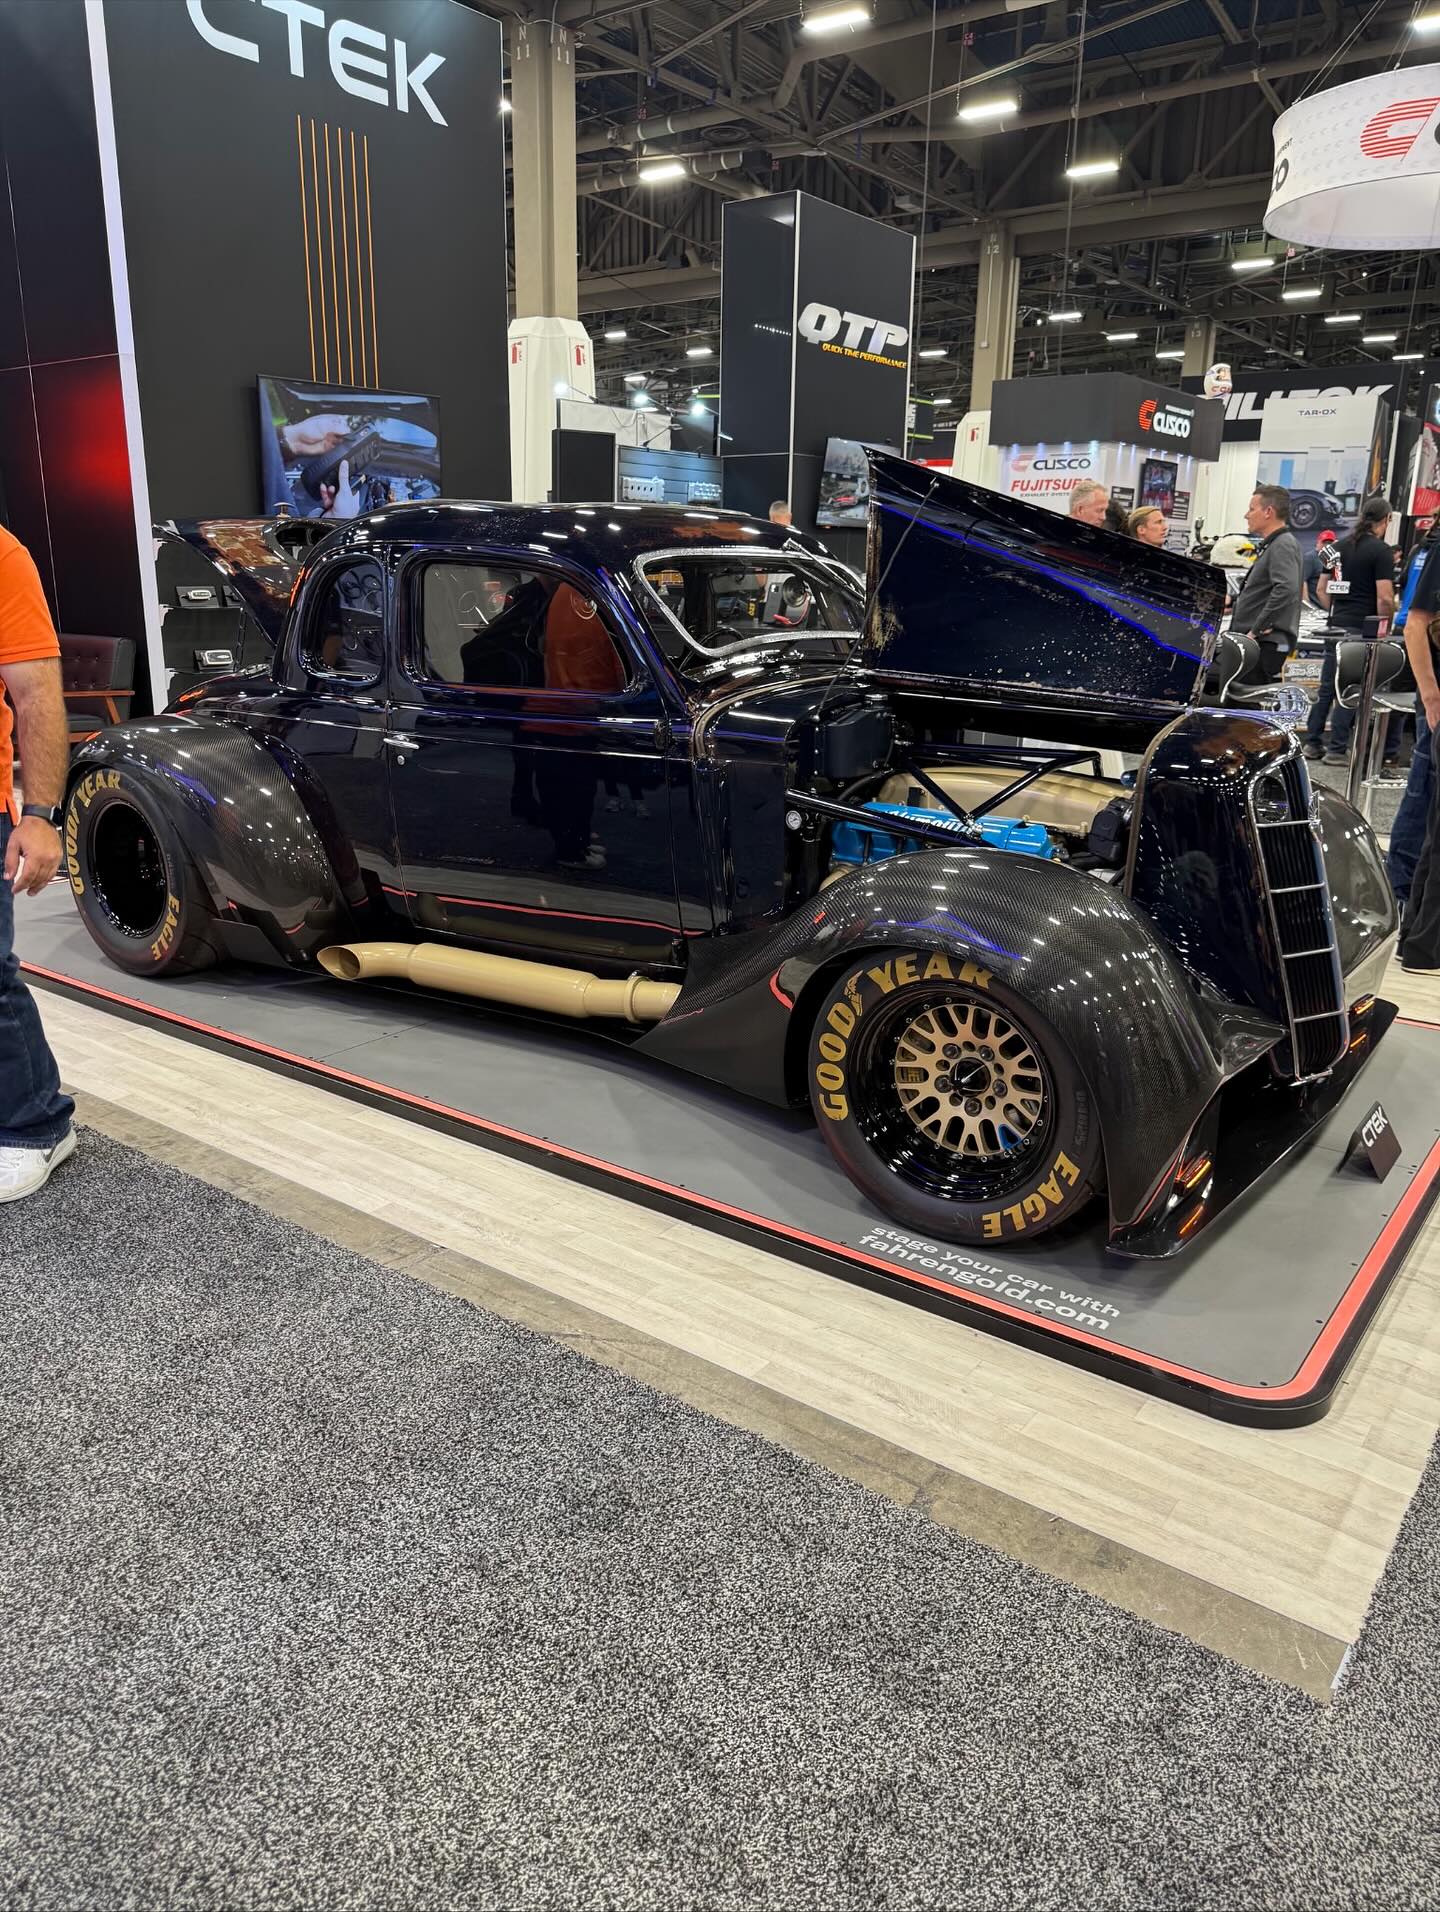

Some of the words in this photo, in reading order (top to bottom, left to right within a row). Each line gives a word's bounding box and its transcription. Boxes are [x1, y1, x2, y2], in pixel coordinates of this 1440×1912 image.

[186, 0, 449, 127] CTEK
[798, 302, 909, 355] QTP
[822, 342, 843, 354] QUICK
[844, 348, 860, 358] TIME
[860, 351, 907, 369] PERFORMANCE
[1153, 411, 1191, 439] CUSCO
[1011, 478, 1093, 493] FUJITSU
[1033, 458, 1091, 471] CUSCO
[151, 894, 180, 961] EAGLE
[1362, 1106, 1389, 1148] CTEK
[981, 1151, 1081, 1239] EAGLE
[858, 1234, 1110, 1331] fahrengold.com
[871, 1227, 939, 1255] stage
[940, 1250, 1003, 1277] your
[1007, 1273, 1054, 1294] car
[1058, 1289, 1121, 1319] with
